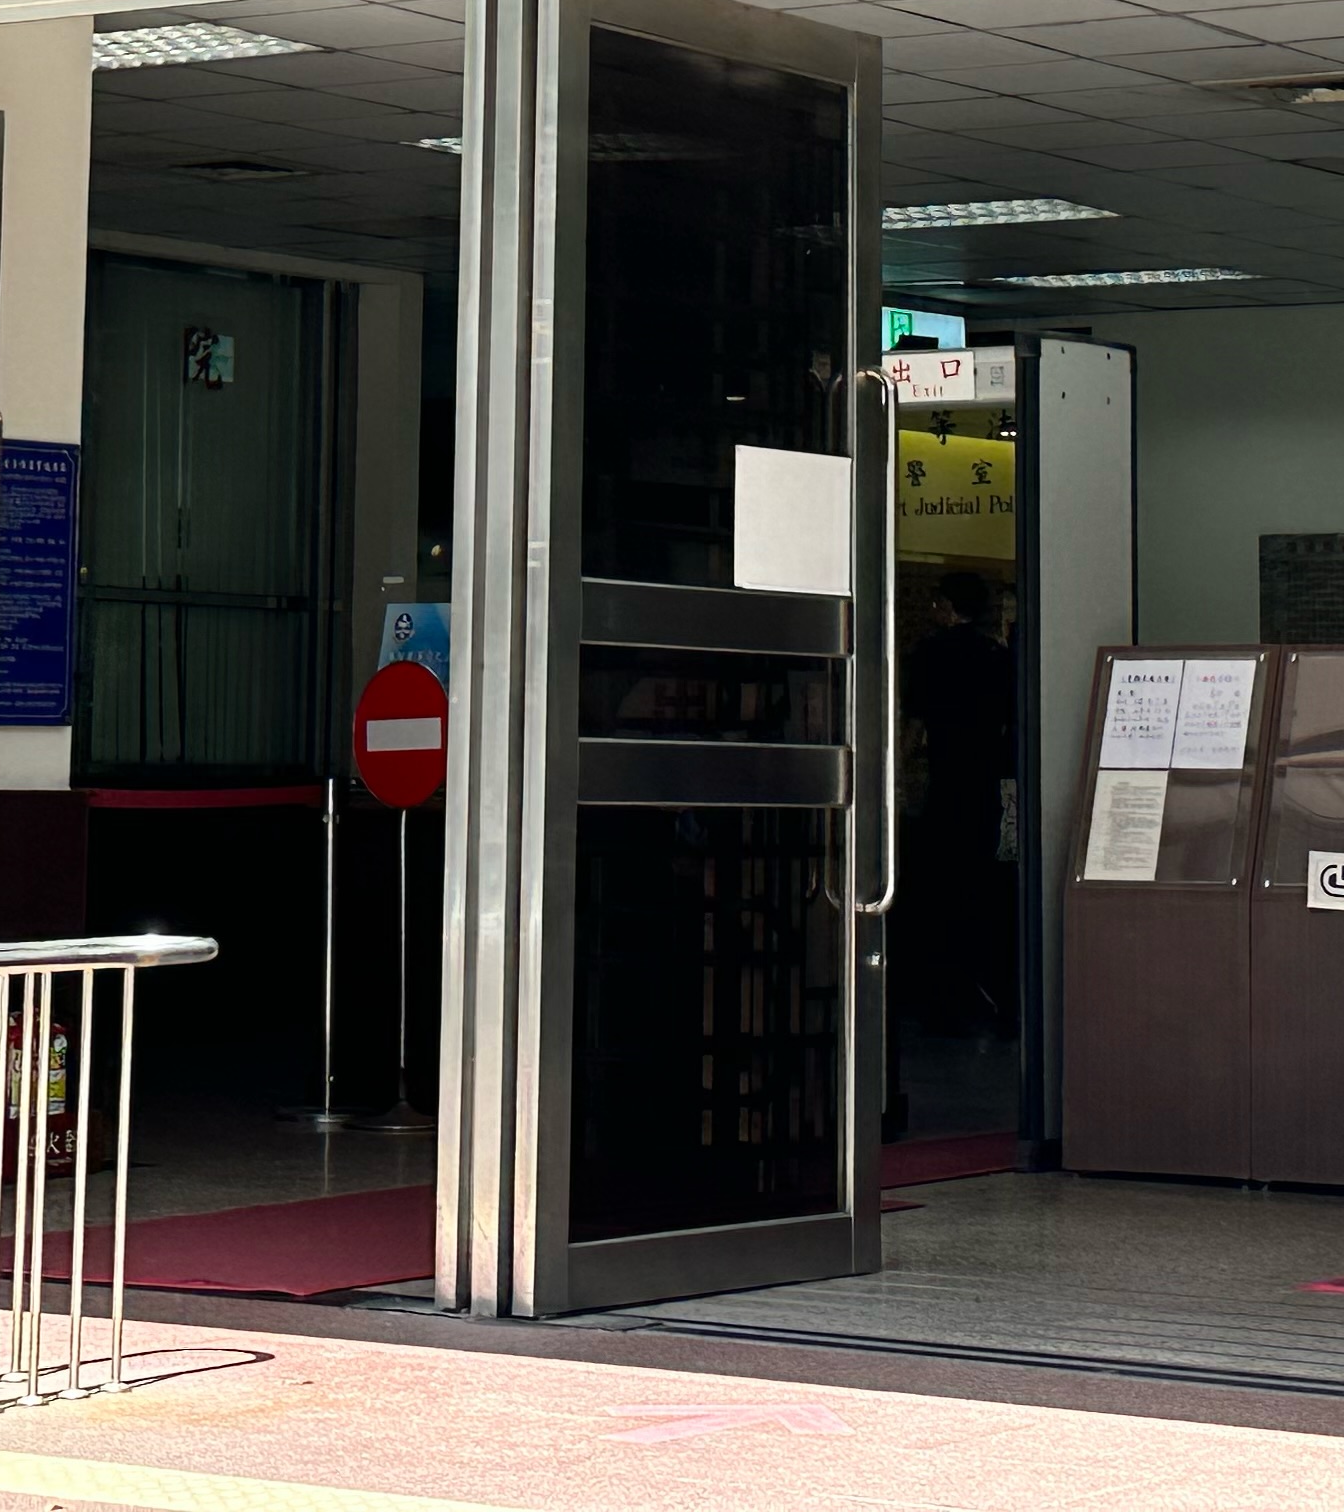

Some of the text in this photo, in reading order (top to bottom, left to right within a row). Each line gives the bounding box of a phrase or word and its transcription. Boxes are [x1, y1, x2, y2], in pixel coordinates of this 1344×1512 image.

[892, 358, 962, 383] 出口
[912, 383, 944, 398] Exit
[913, 495, 981, 517] Judicial
